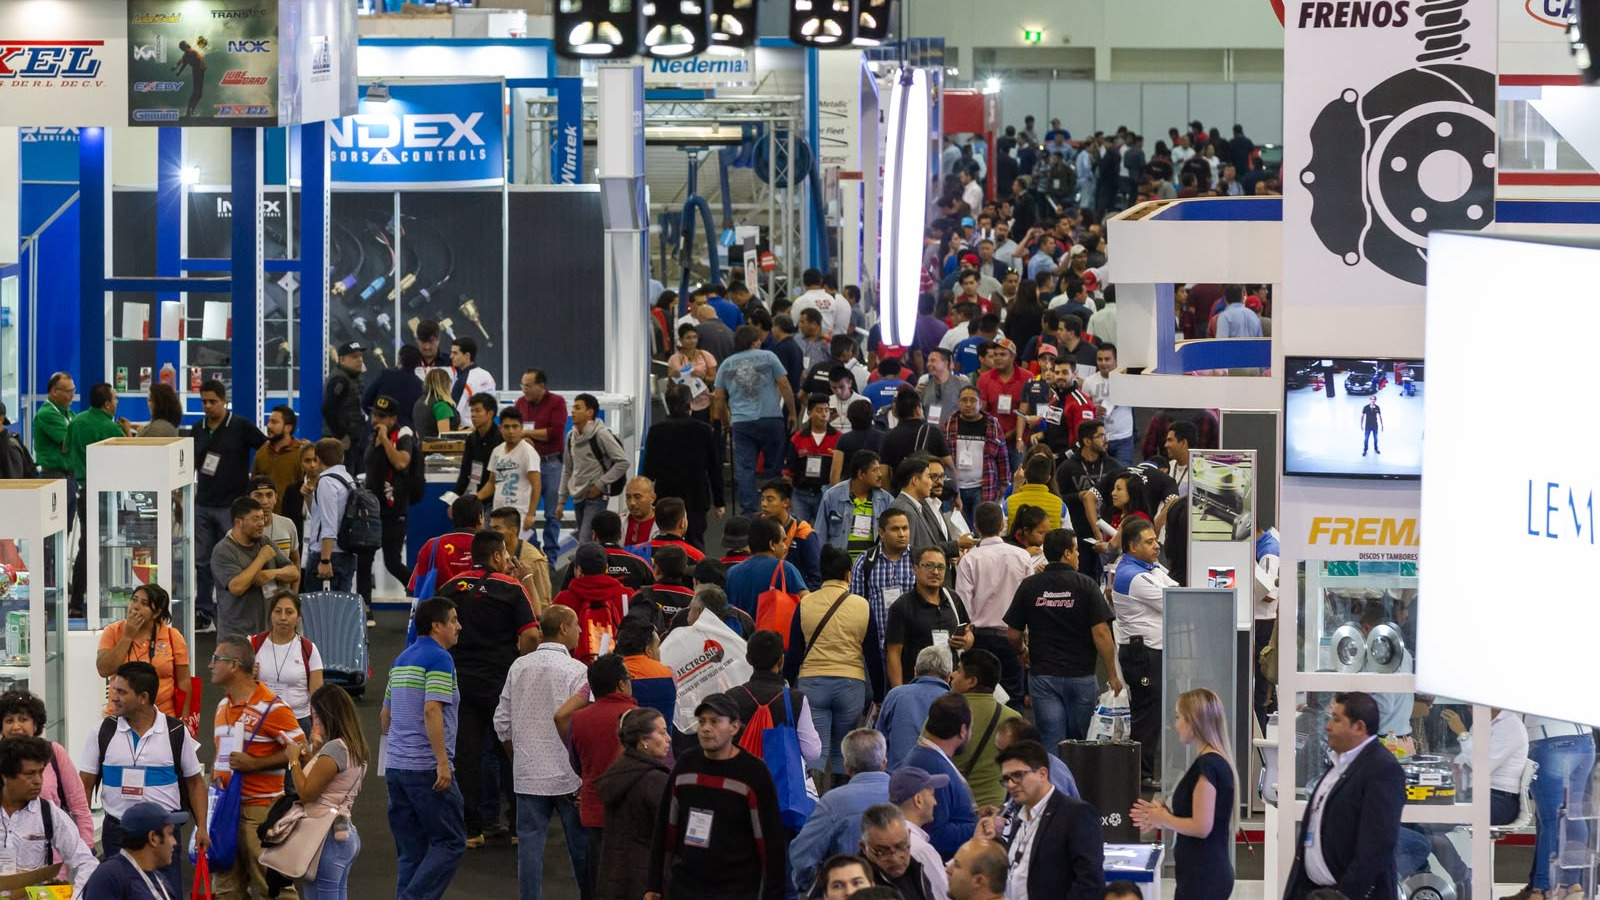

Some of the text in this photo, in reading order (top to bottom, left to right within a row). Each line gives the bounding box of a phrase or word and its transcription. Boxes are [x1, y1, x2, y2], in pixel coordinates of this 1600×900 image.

[1298, 1, 1409, 28] FRENOS
[228, 40, 270, 53] NOK
[652, 56, 749, 73] Nederman
[134, 81, 185, 92] EXEDY
[401, 148, 487, 162] CONTROLS
[561, 122, 577, 185] Wintek
[1308, 516, 1420, 547] FREM
[1359, 552, 1380, 560] DISCOS
[1386, 553, 1418, 561] TAMBORES
